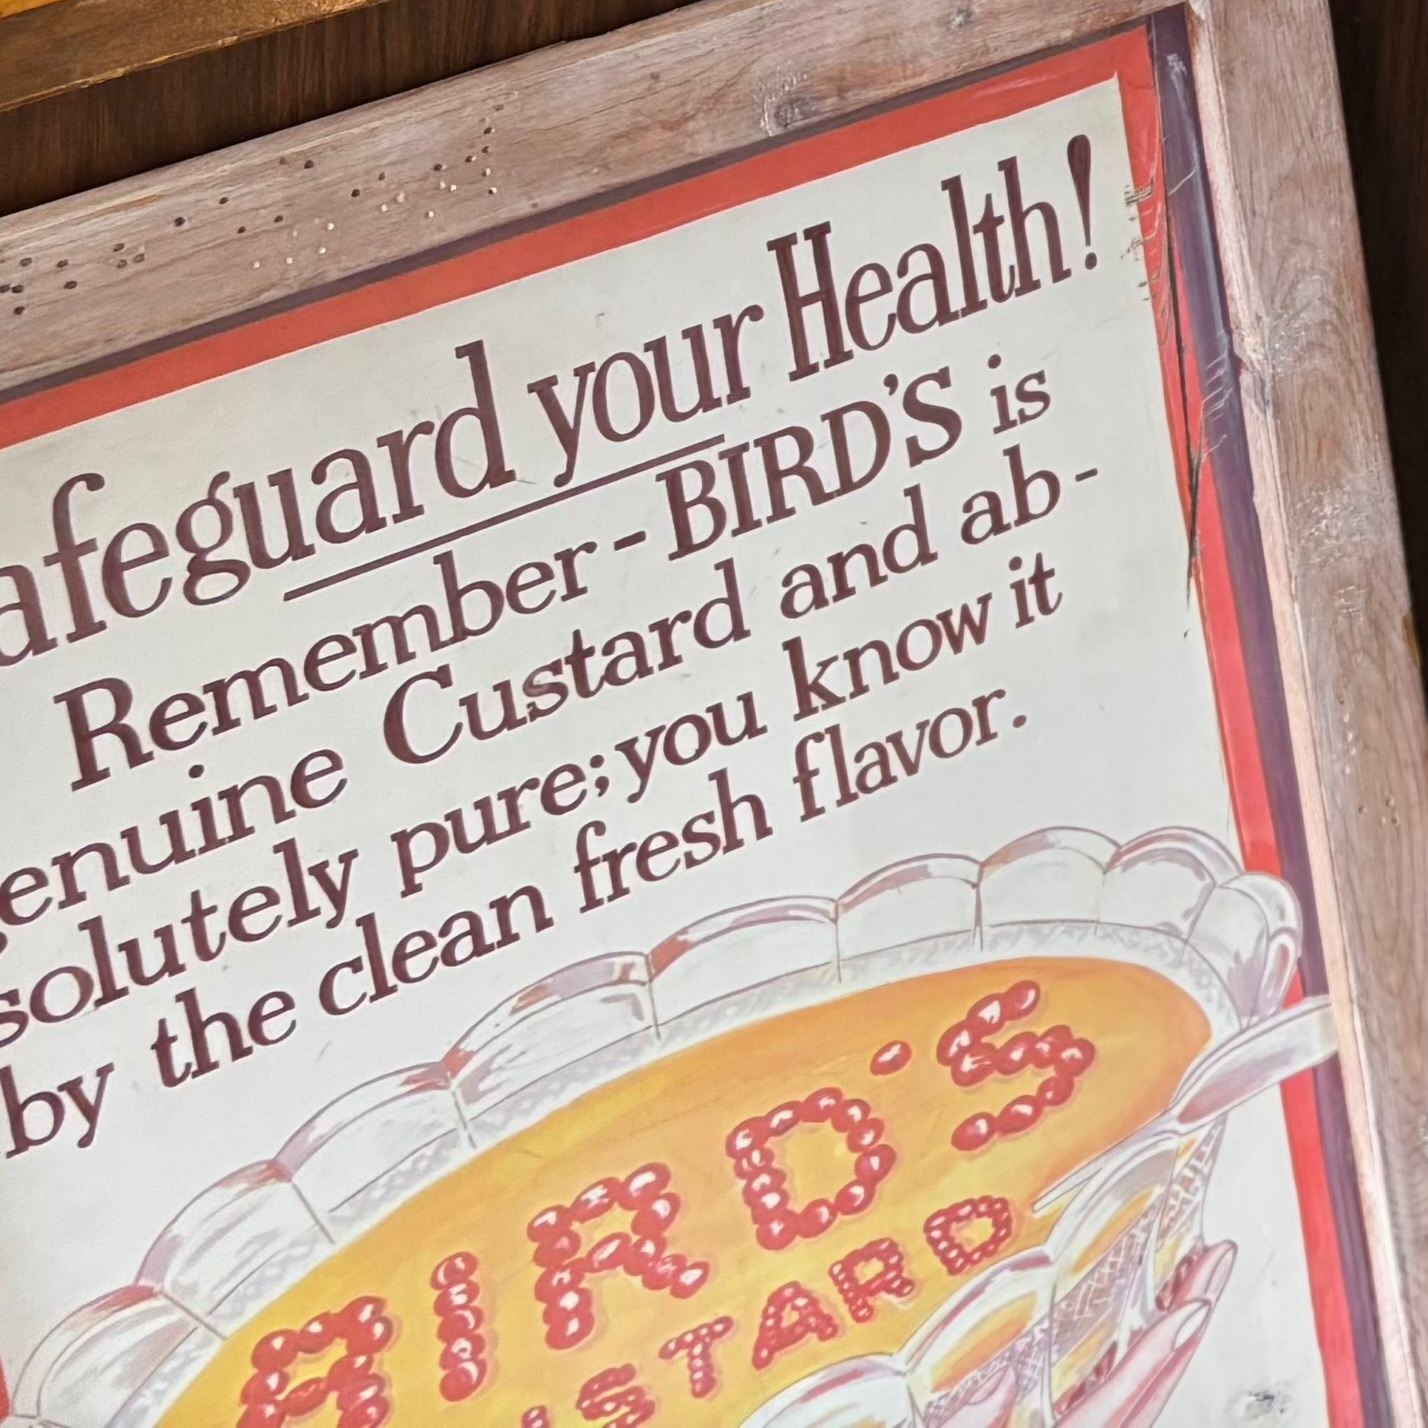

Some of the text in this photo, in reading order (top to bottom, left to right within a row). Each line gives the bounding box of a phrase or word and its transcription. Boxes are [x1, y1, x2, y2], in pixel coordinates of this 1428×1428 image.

[527, 305, 763, 488] your
[765, 132, 1099, 382] Health!
[989, 353, 1051, 435] is
[0, 749, 348, 926] enuine
[383, 557, 751, 765] Custard
[780, 483, 938, 619] and
[781, 592, 993, 722] know
[1009, 552, 1063, 629] it
[0, 689, 1029, 1159] by the clean fresh flavor.
[522, 1195, 1013, 1428] STARD
